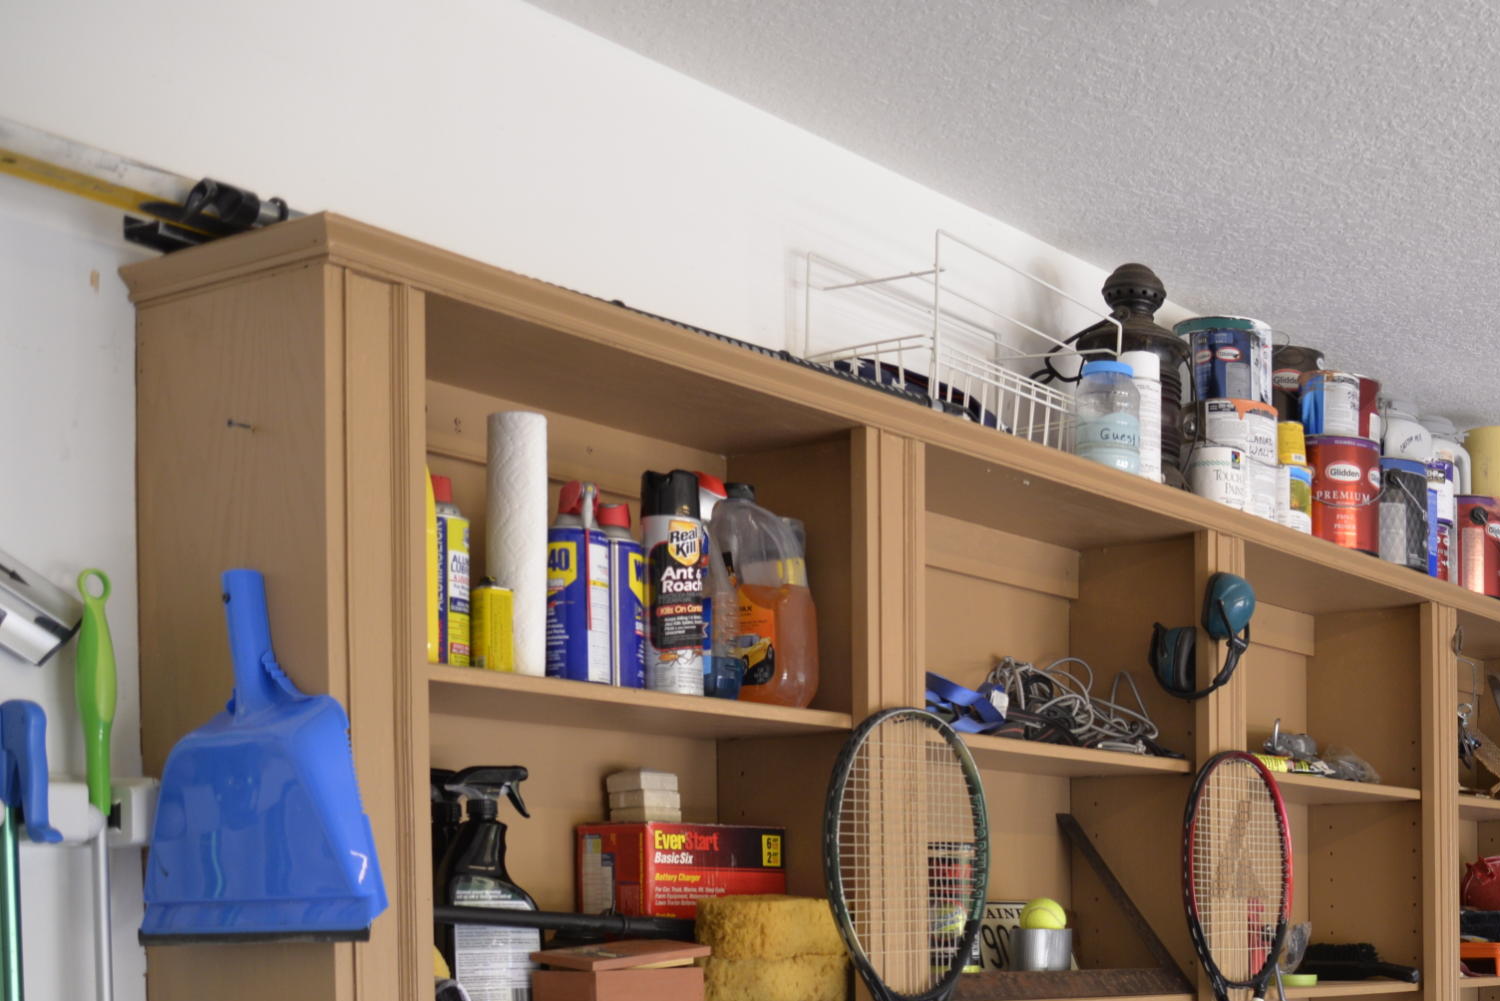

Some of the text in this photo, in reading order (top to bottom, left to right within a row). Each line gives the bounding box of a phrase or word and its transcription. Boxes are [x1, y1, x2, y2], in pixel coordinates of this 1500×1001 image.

[1329, 467, 1360, 480] Glidden
[1316, 489, 1371, 503] PREMIUM
[669, 528, 698, 544] Real
[675, 541, 698, 558] Kill
[661, 566, 693, 582] Ant
[661, 579, 703, 594] Roach
[654, 830, 720, 851] EverStart
